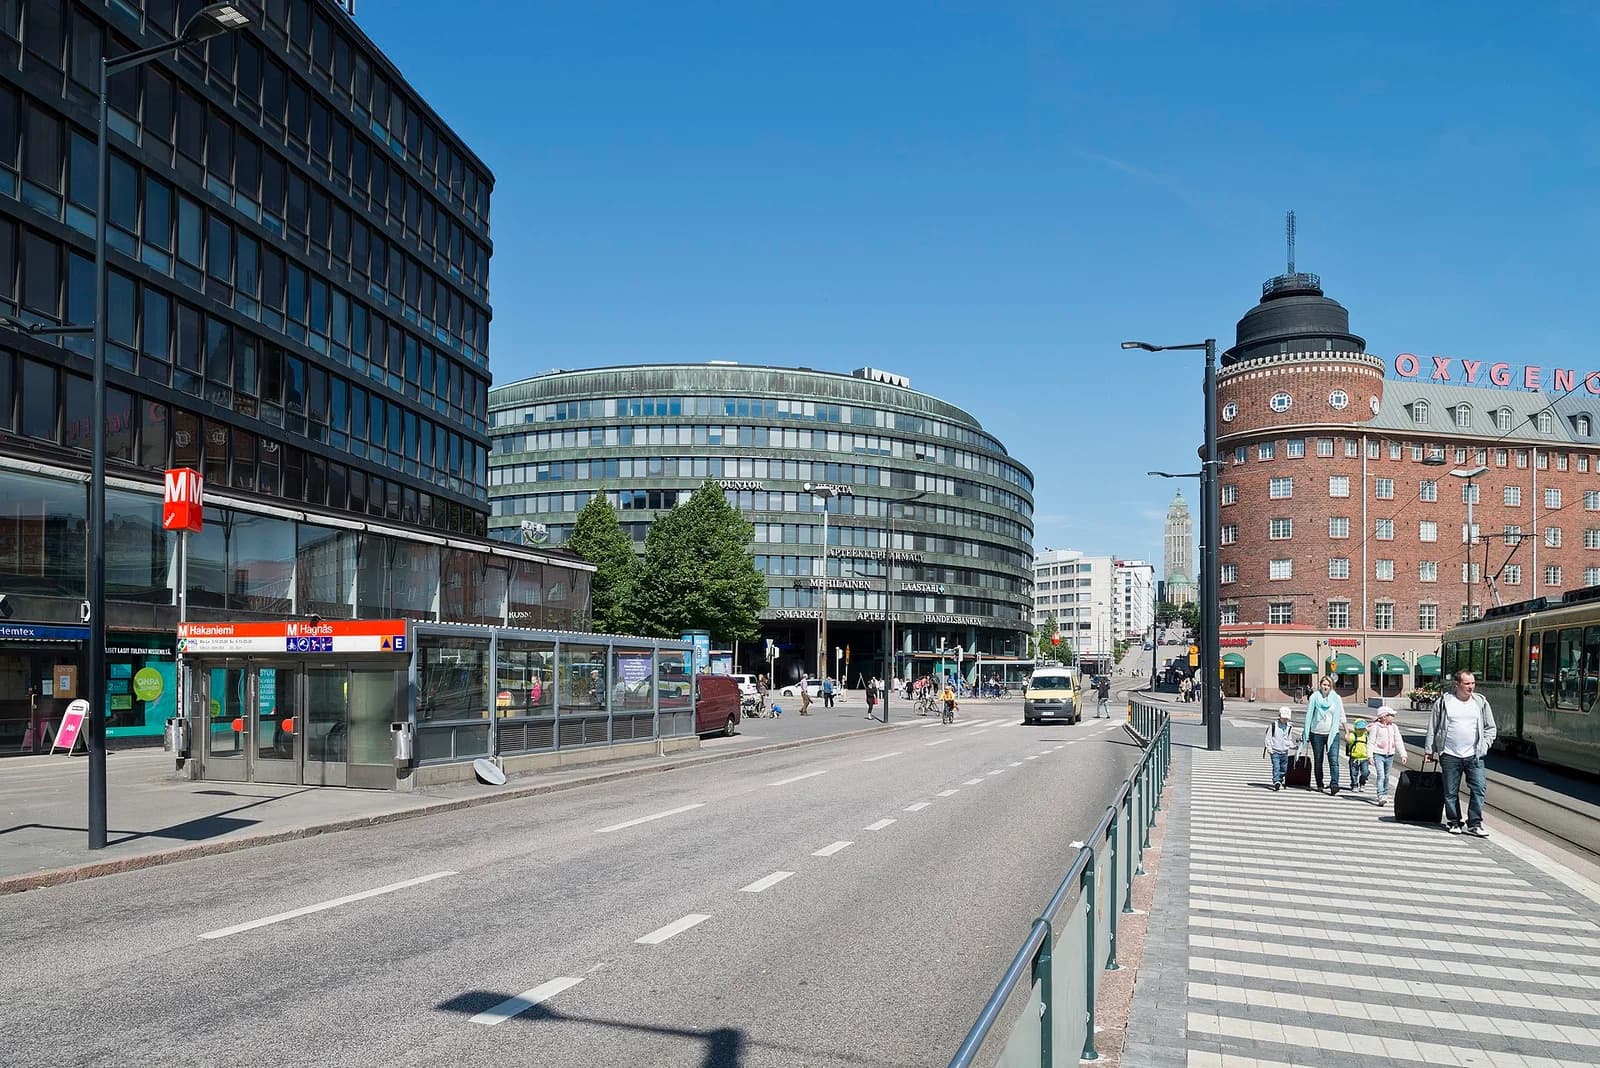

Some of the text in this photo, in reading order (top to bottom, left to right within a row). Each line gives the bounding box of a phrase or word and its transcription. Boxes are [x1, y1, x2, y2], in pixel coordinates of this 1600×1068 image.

[165, 471, 187, 503] M
[190, 472, 203, 506] M
[925, 614, 982, 625] HANDELSBANKEN
[0, 627, 35, 636] Hemtex
[178, 625, 234, 636] M Hakaniemi
[287, 623, 333, 636] M Hagnäs
[395, 638, 403, 649] E
